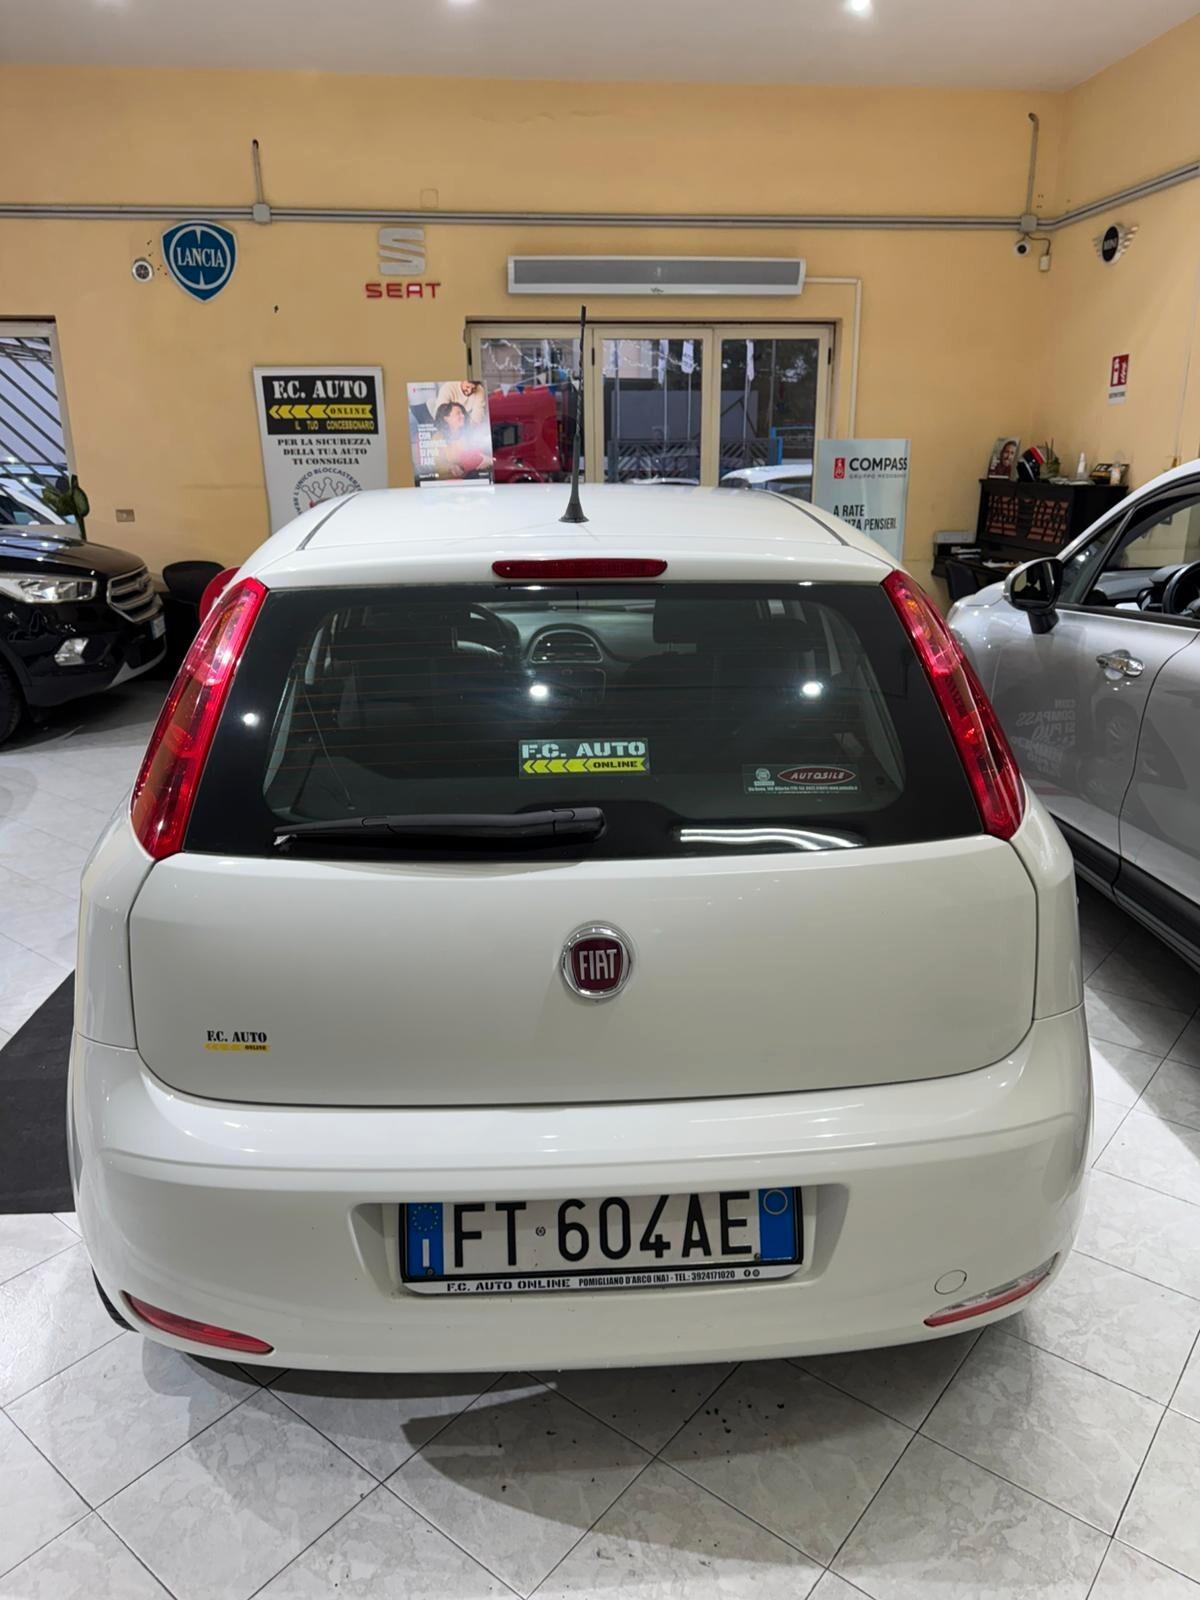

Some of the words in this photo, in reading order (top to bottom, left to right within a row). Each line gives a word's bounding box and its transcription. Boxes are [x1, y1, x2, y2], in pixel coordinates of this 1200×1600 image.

[176, 247, 225, 268] LANCIA
[365, 282, 442, 299] SEAT
[272, 380, 306, 399] F.C.
[312, 380, 367, 399] AUTO
[330, 405, 368, 415] ONLINE
[277, 438, 298, 446] PER
[301, 438, 313, 446] LA
[315, 438, 371, 446] SICUREZZA
[283, 448, 314, 456] DELLA
[317, 448, 338, 456] TUA
[340, 448, 367, 456] AUTO
[292, 457, 303, 465] TI
[306, 457, 360, 466] CONSIGLIA
[849, 457, 908, 471] COMPASS
[833, 504, 840, 517] A
[842, 504, 865, 517] RATE
[522, 743, 567, 758] F.C.
[576, 741, 646, 757] AUTO
[593, 760, 638, 769] ONLINE
[790, 772, 845, 780] AUTOSILE
[579, 949, 617, 980] FIAT
[206, 1030, 228, 1042] F.C.
[232, 1031, 268, 1043] AUTO
[454, 1201, 527, 1268] FT
[558, 1191, 753, 1262] 604AE
[422, 1238, 430, 1267] I
[447, 1281, 470, 1292] F.C.
[475, 1280, 512, 1291] AUTO
[517, 1278, 571, 1289] ONLINE
[579, 1276, 626, 1288] POMIGLIANO
[626, 1275, 653, 1285] D'ARCO
[653, 1273, 669, 1284] (NA)
[691, 1270, 736, 1281] 3924171020
